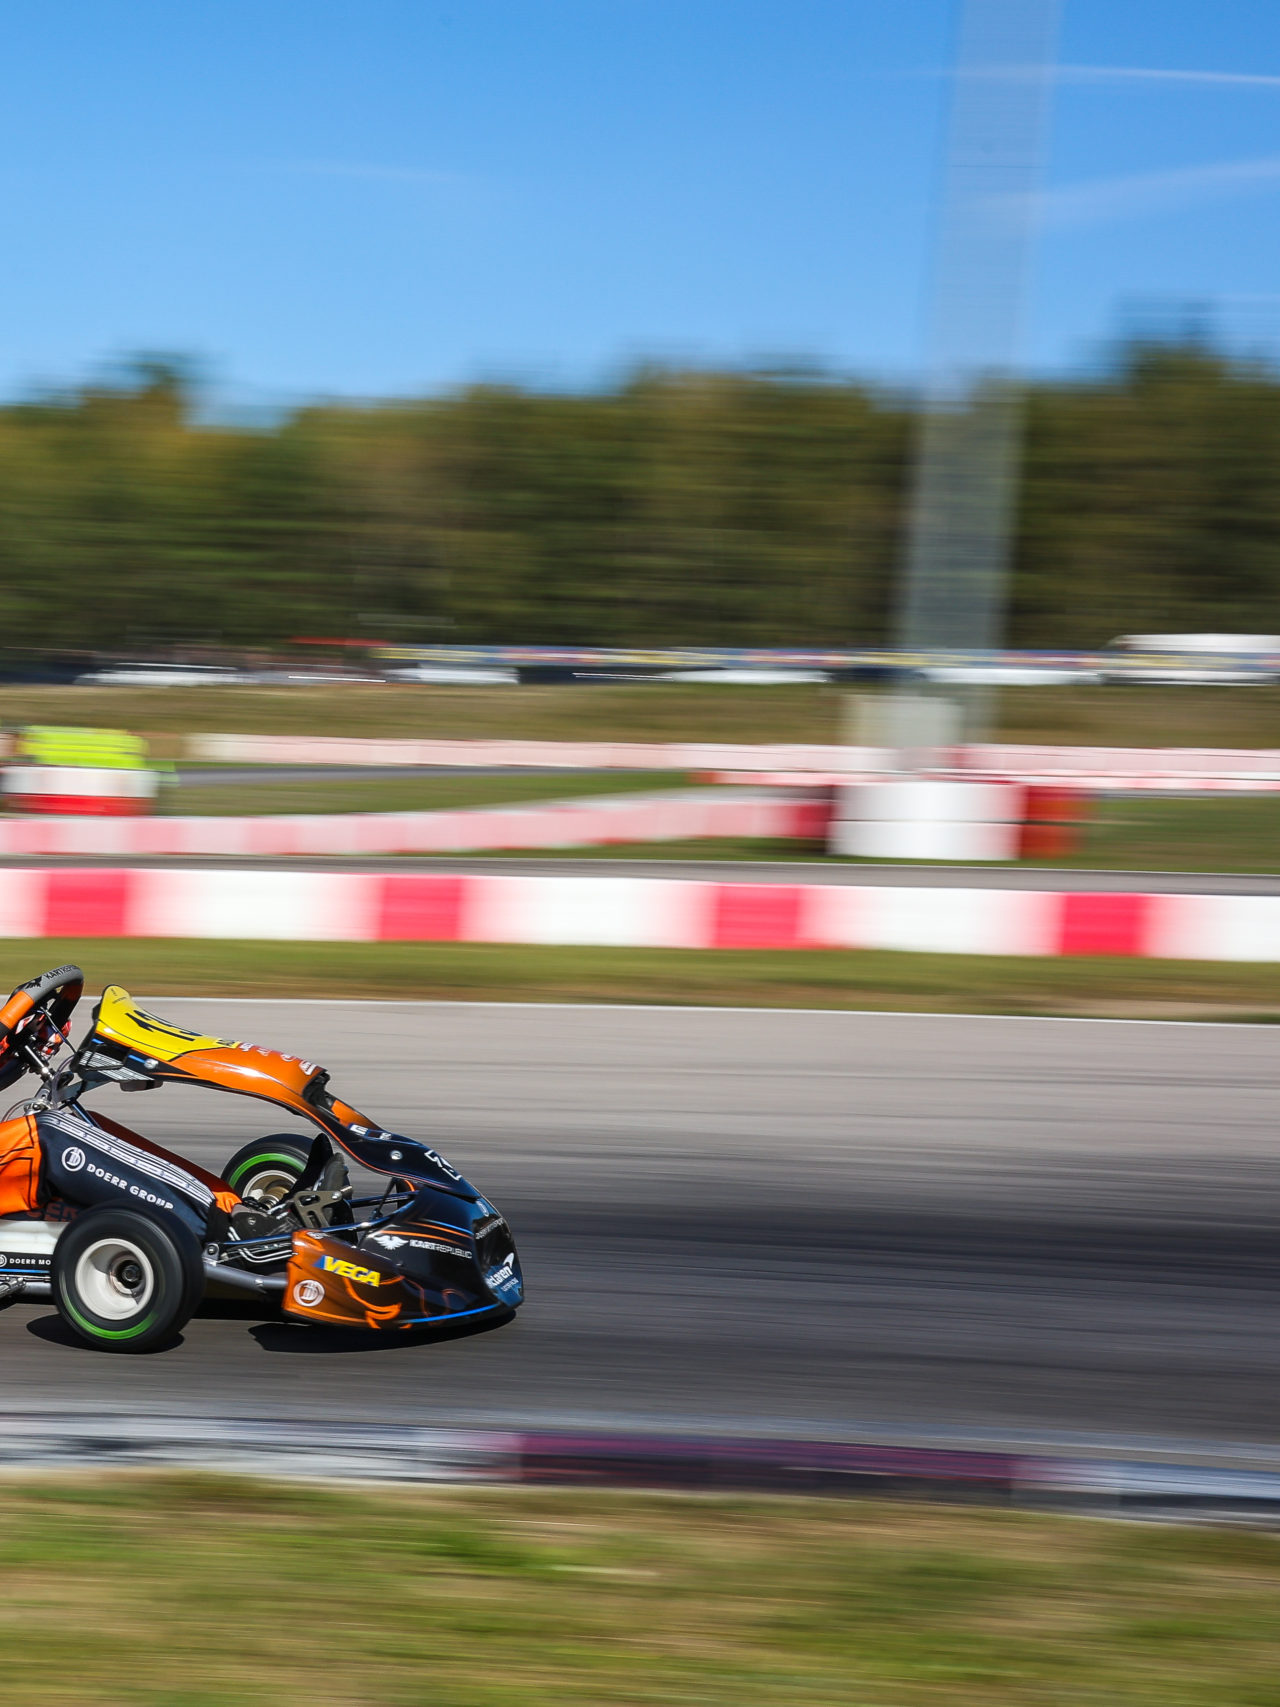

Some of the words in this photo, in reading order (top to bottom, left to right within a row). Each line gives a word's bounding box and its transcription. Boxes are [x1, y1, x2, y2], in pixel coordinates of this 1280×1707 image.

[86, 1163, 128, 1190] DOERR
[129, 1185, 174, 1210] GROUP
[324, 1255, 381, 1288] VEGA
